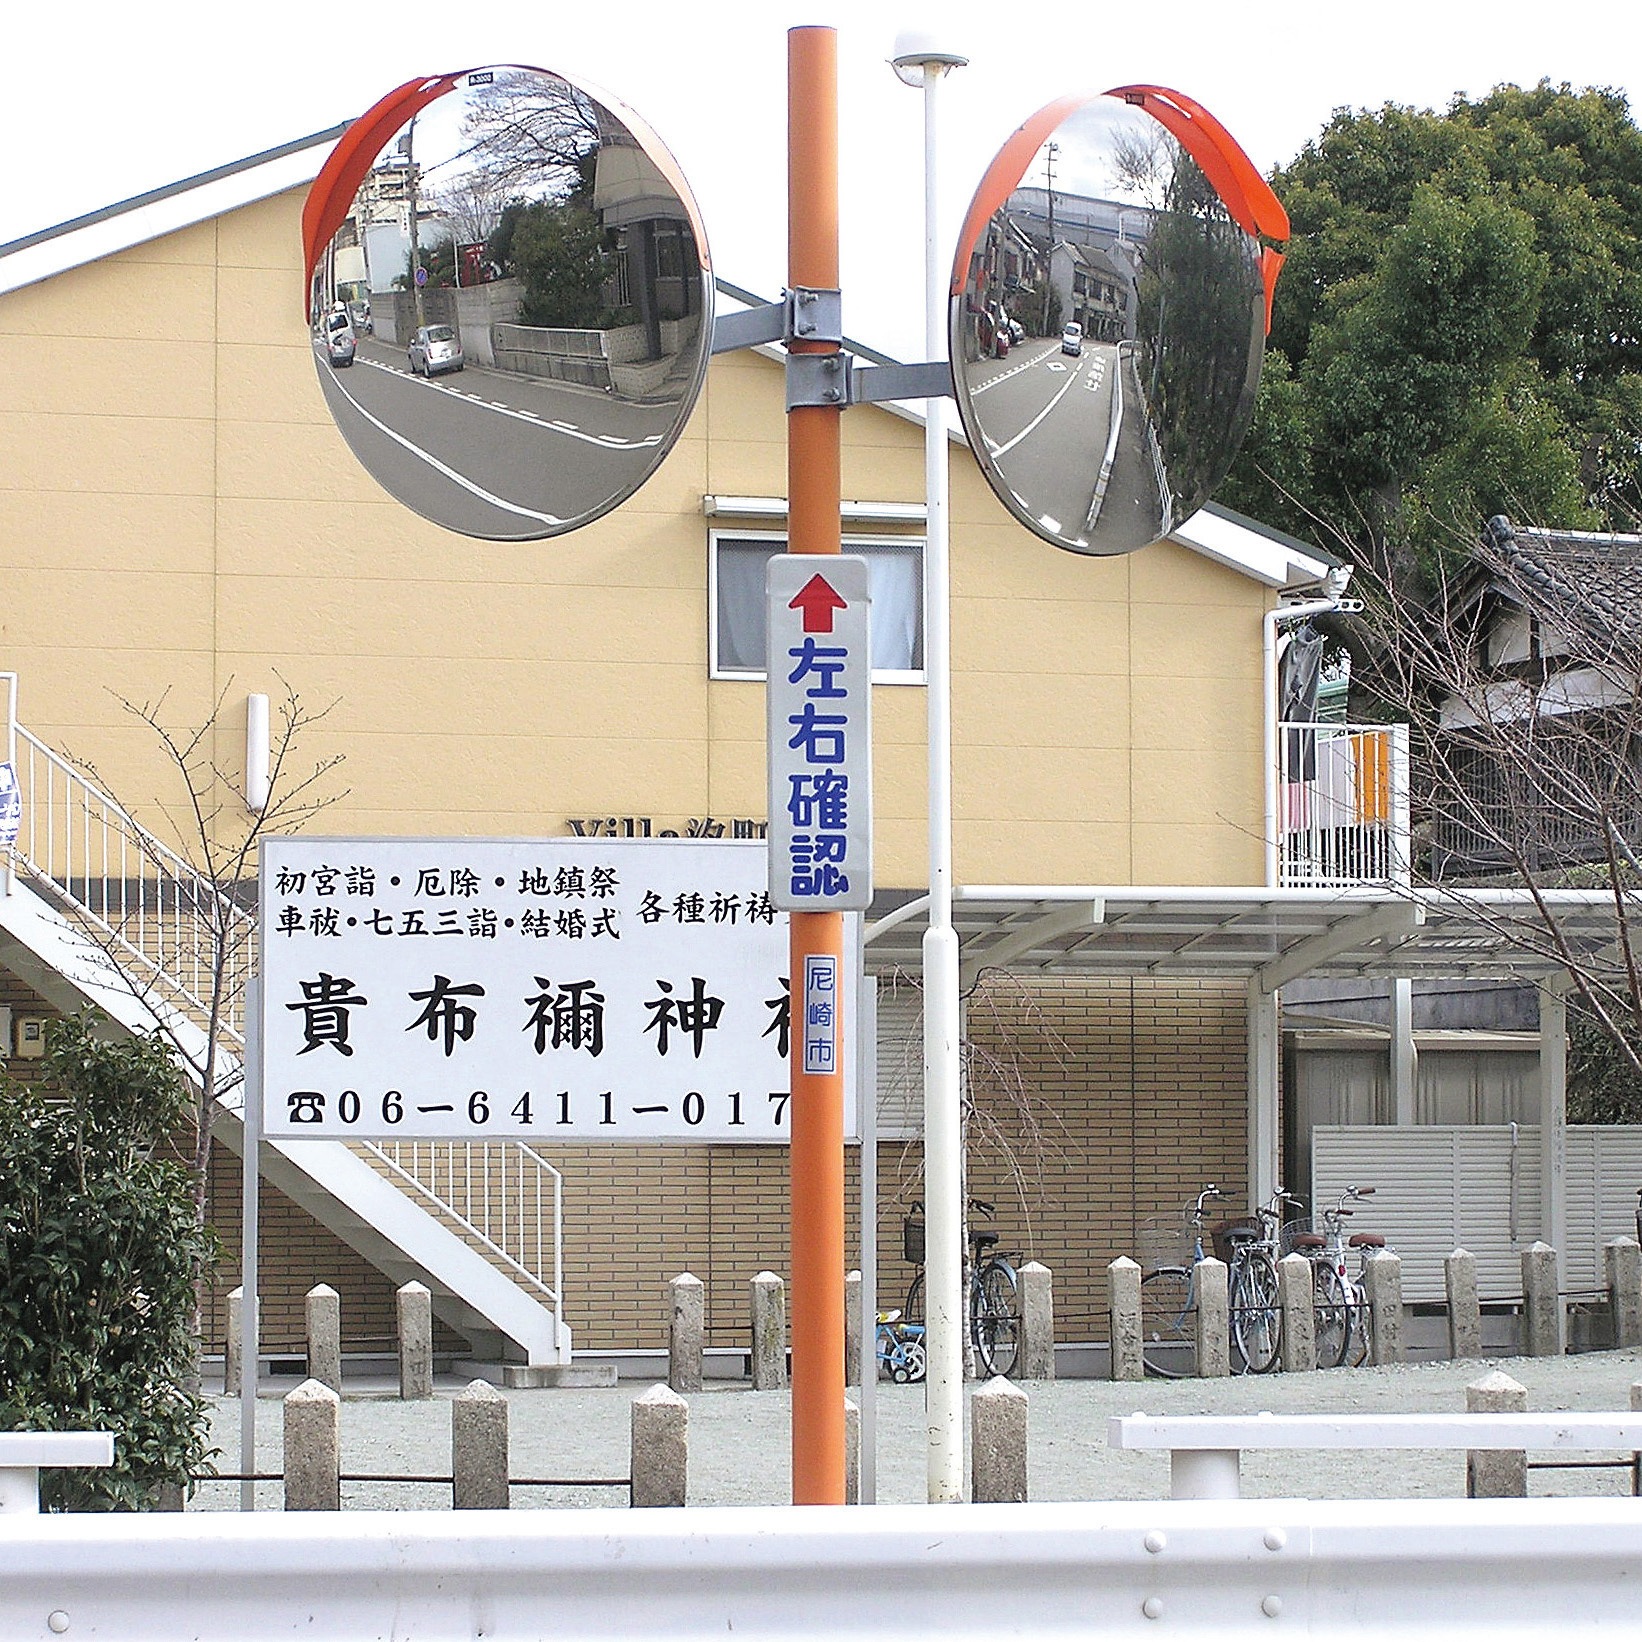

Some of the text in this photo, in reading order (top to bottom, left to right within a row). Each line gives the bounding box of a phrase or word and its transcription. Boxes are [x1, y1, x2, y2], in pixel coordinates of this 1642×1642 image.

[787, 636, 849, 897] 左右確認
[636, 889, 790, 926] 各種祈祷
[809, 966, 833, 1063] 尼崎市
